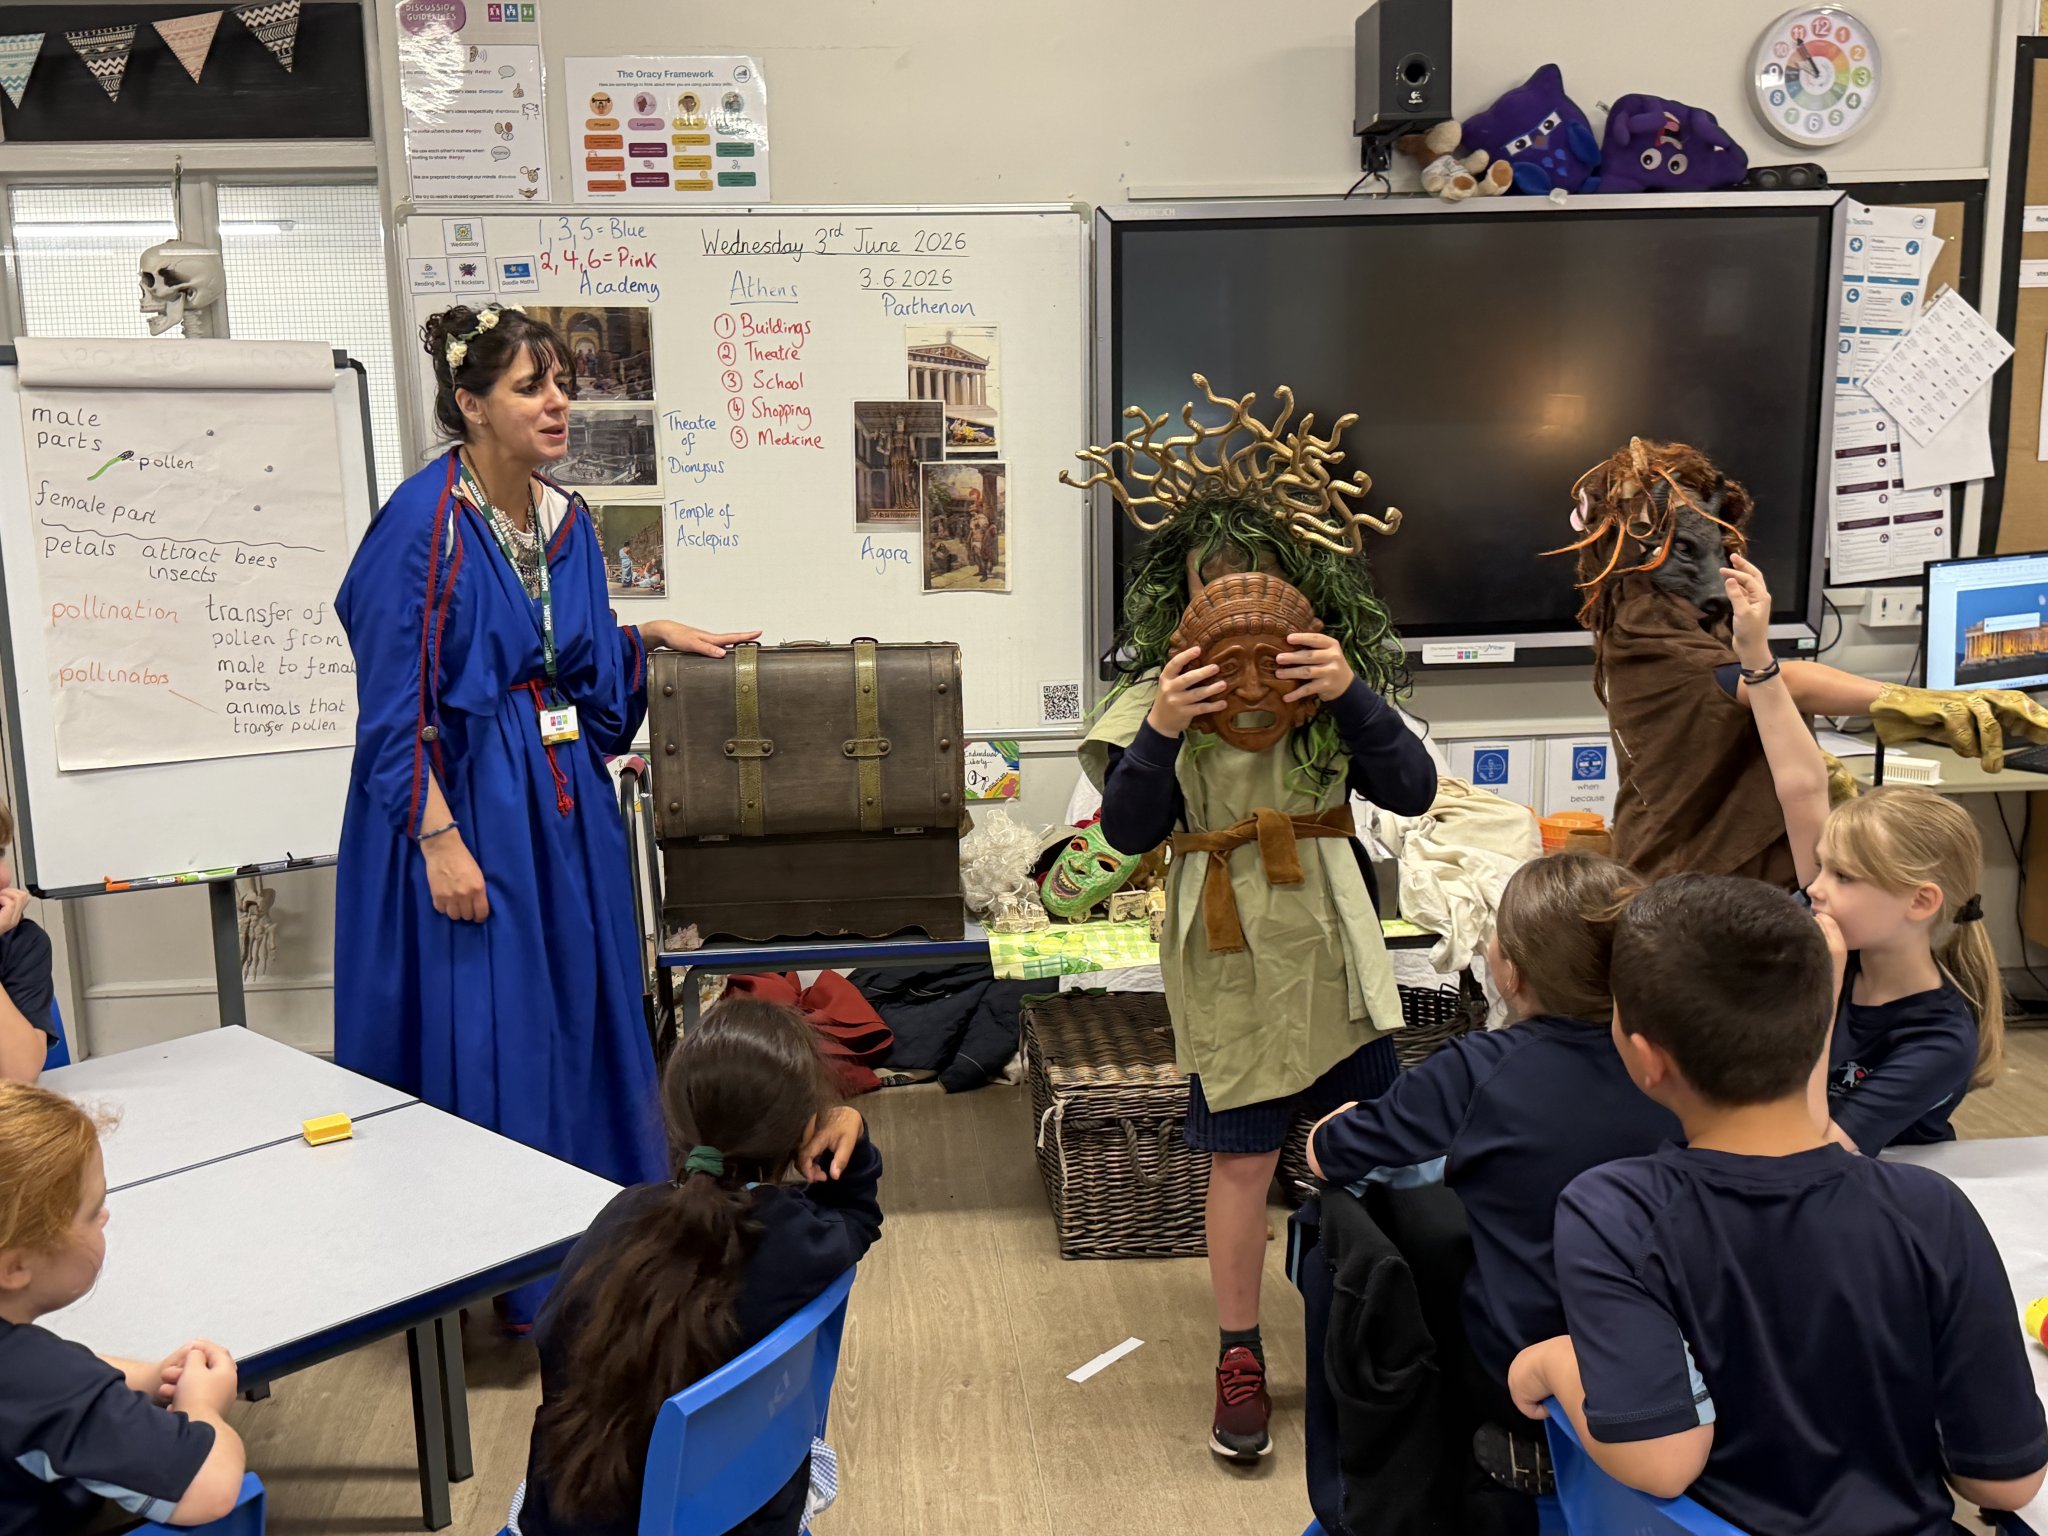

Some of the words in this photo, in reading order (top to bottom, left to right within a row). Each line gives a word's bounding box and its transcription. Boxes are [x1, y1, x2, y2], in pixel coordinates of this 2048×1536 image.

[405, 3, 456, 12] DISCUSSION
[617, 70, 634, 78] The
[636, 70, 662, 79] Oracy
[664, 70, 714, 78] Framework
[609, 217, 647, 239] Blue
[701, 228, 803, 262] Wednesday
[814, 222, 844, 255] 3rd
[853, 227, 901, 253] June
[914, 230, 967, 253] 2026
[617, 246, 657, 269] Pink
[579, 269, 660, 303] Academy
[730, 270, 798, 299] Athens
[882, 293, 975, 317] Parthenon
[740, 312, 811, 348] Buildings
[744, 341, 801, 361] Theatre
[753, 369, 804, 390] School
[32, 407, 102, 427] male
[663, 410, 717, 431] Theatre
[751, 396, 812, 431] Shopping
[37, 431, 102, 451] parts
[681, 432, 696, 456] of
[758, 428, 824, 449] Medicine
[139, 454, 194, 471] pollen
[668, 456, 725, 483] Dionysus
[35, 480, 106, 516] female
[113, 507, 157, 524] part
[467, 480, 486, 507] VISITOR
[669, 499, 714, 526] Temple
[719, 504, 735, 529] of
[489, 518, 506, 546] VISITOR
[676, 524, 739, 554] Asclepius
[142, 543, 221, 563] attract
[235, 547, 277, 569] bees
[860, 535, 912, 575] Agora
[149, 565, 217, 583] insects
[540, 566, 549, 592] VISITOR
[51, 593, 179, 627] pollination
[205, 593, 294, 628] transfer
[303, 601, 327, 625] of
[543, 604, 552, 631] VISITOR
[212, 628, 275, 648] pollen
[283, 628, 344, 651] from
[217, 654, 266, 675] male
[278, 655, 298, 673] to
[304, 656, 356, 680] femal
[224, 678, 271, 693] parts
[226, 699, 301, 716] animals
[309, 699, 346, 713] that
[234, 717, 284, 737] transfer
[292, 720, 336, 734] pollen
[1570, 795, 1605, 803] because
[1577, 783, 1599, 791] when
